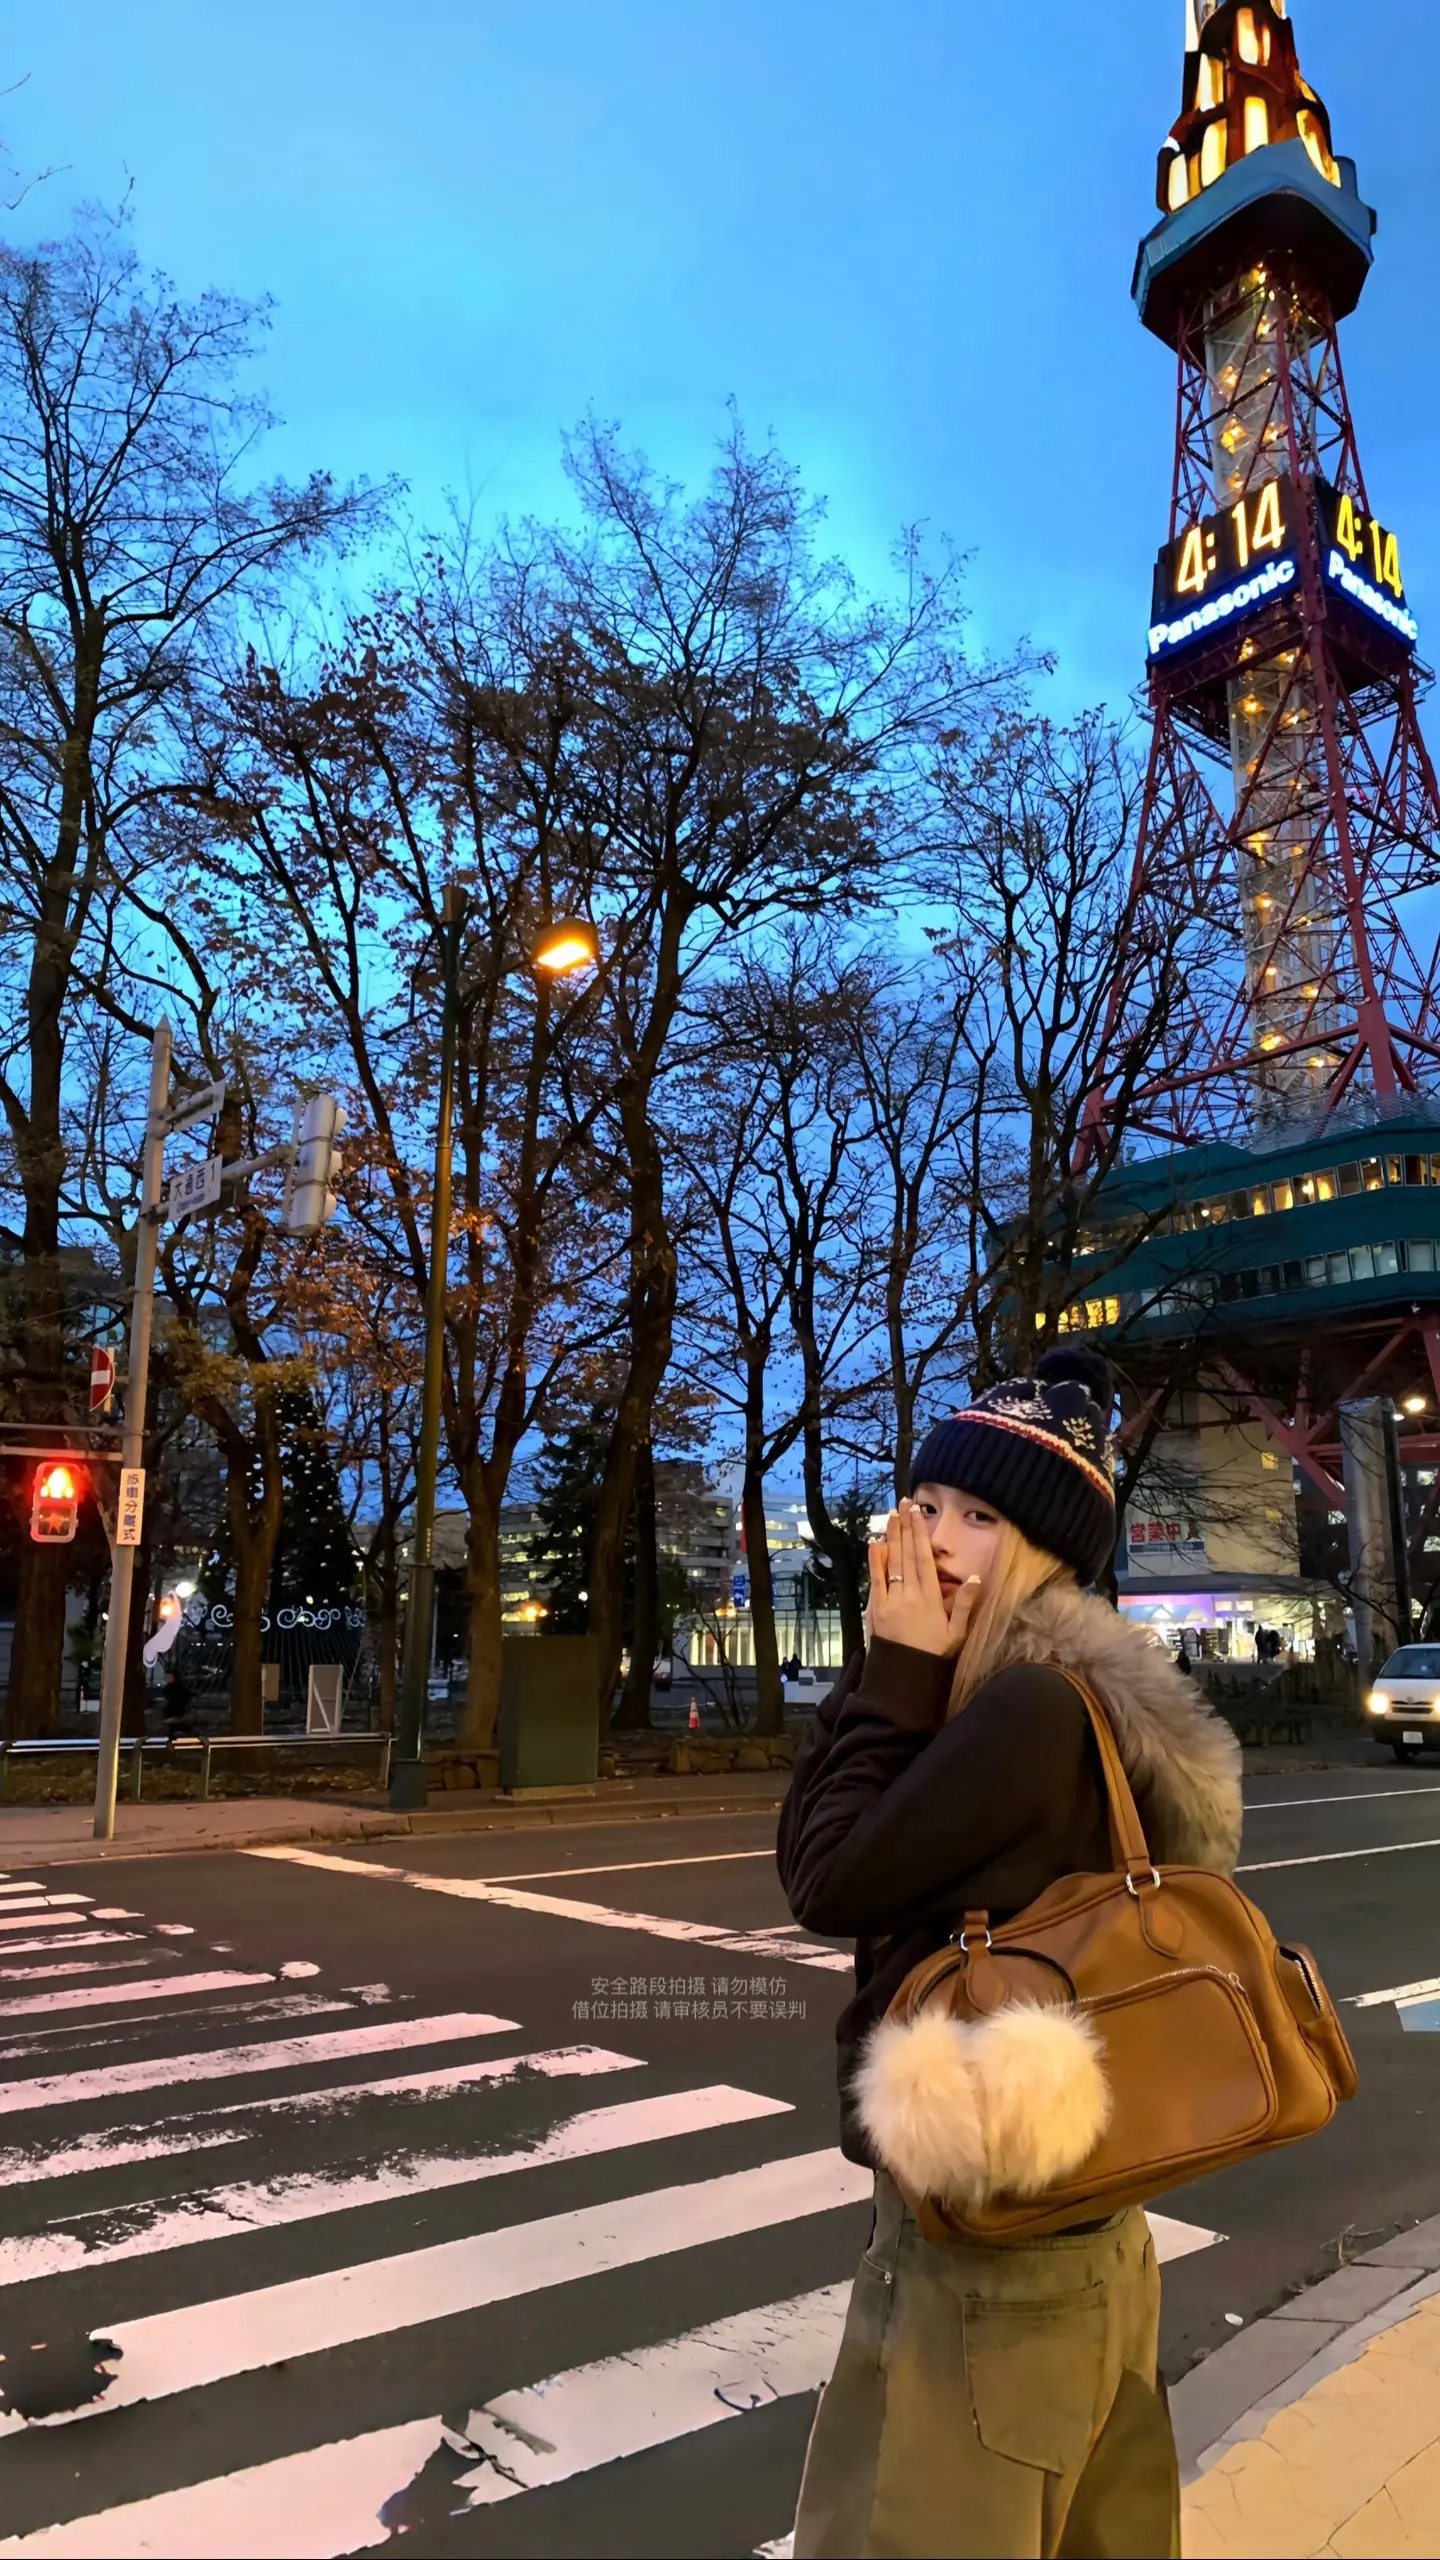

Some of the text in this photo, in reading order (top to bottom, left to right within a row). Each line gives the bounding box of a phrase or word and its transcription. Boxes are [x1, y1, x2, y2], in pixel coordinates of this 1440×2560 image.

[1148, 559, 1296, 654] Panasonic
[1329, 549, 1418, 640] Panasonic
[1130, 1520, 1182, 1543] 営業中
